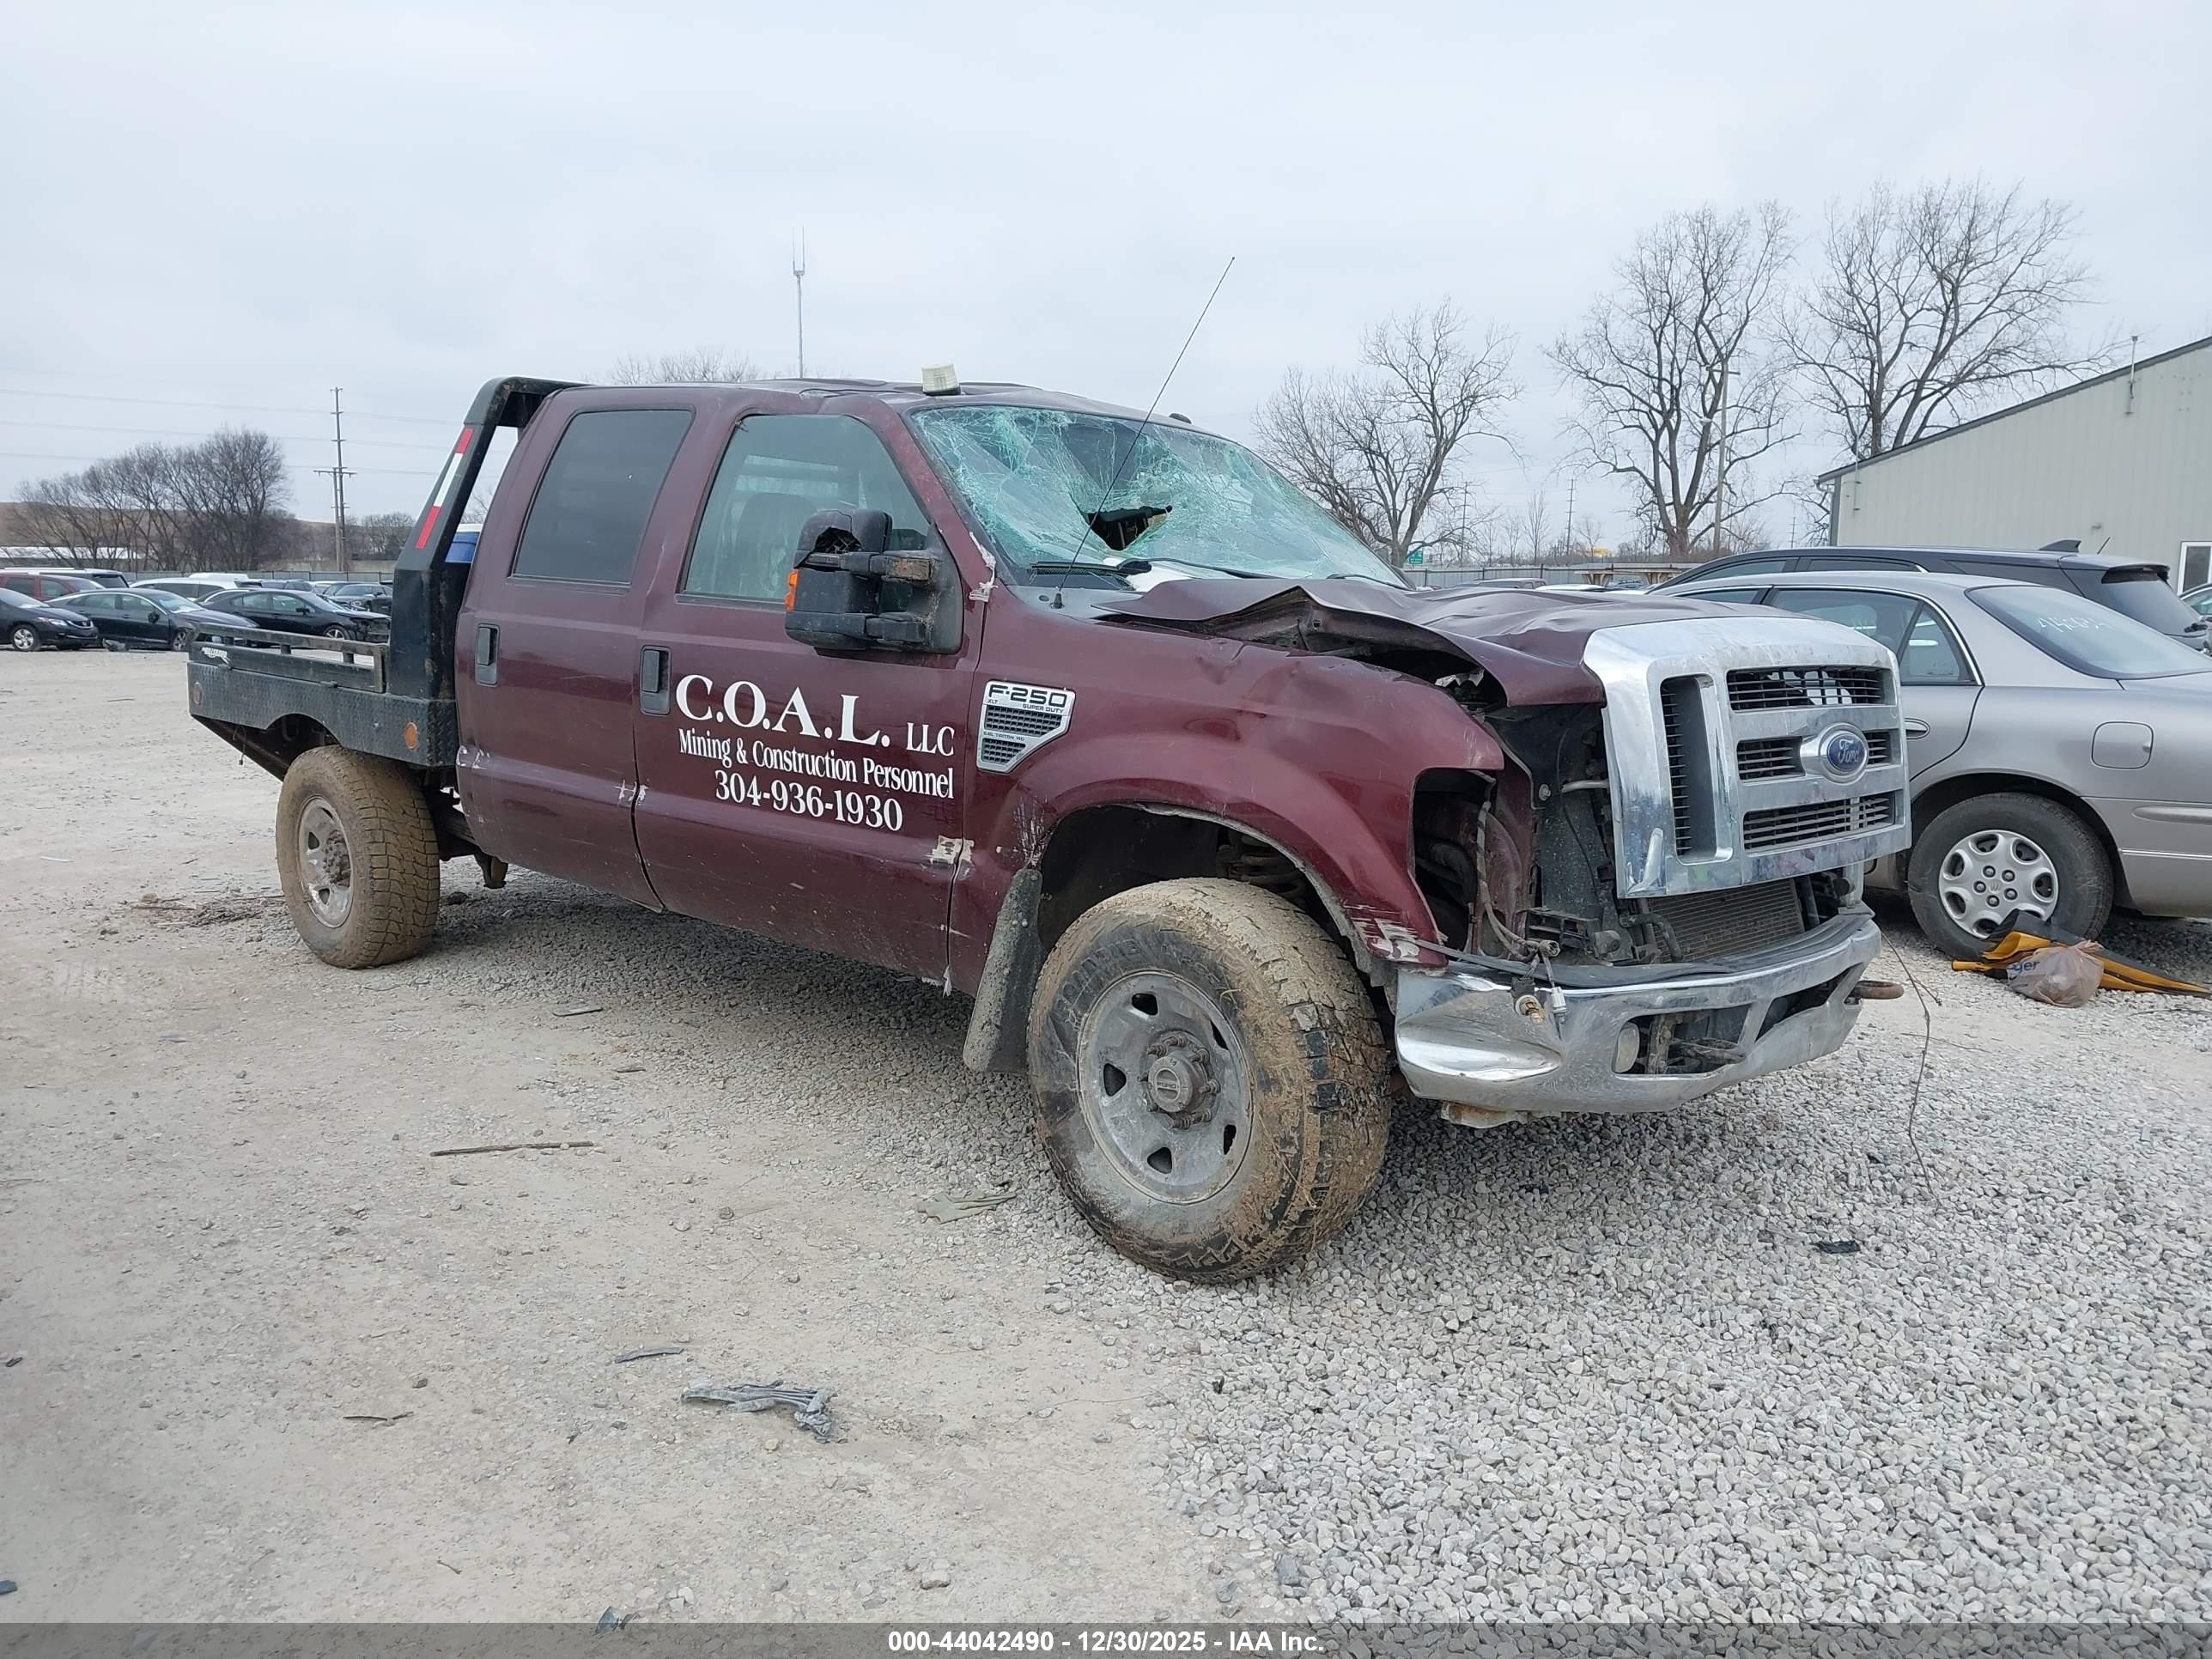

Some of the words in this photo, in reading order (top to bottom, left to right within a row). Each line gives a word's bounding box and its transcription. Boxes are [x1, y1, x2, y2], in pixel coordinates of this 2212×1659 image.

[676, 674, 890, 747] C.O.A.L.
[906, 722, 955, 757] LLC
[1022, 702, 1044, 712] SUPER
[1045, 706, 1064, 714] DUTY
[678, 727, 732, 768] Mining
[735, 736, 750, 765] &
[751, 740, 859, 784] Construction
[862, 757, 955, 799] Personnel
[1838, 738, 1860, 763] Ford
[714, 769, 903, 832] 304-936-1930
